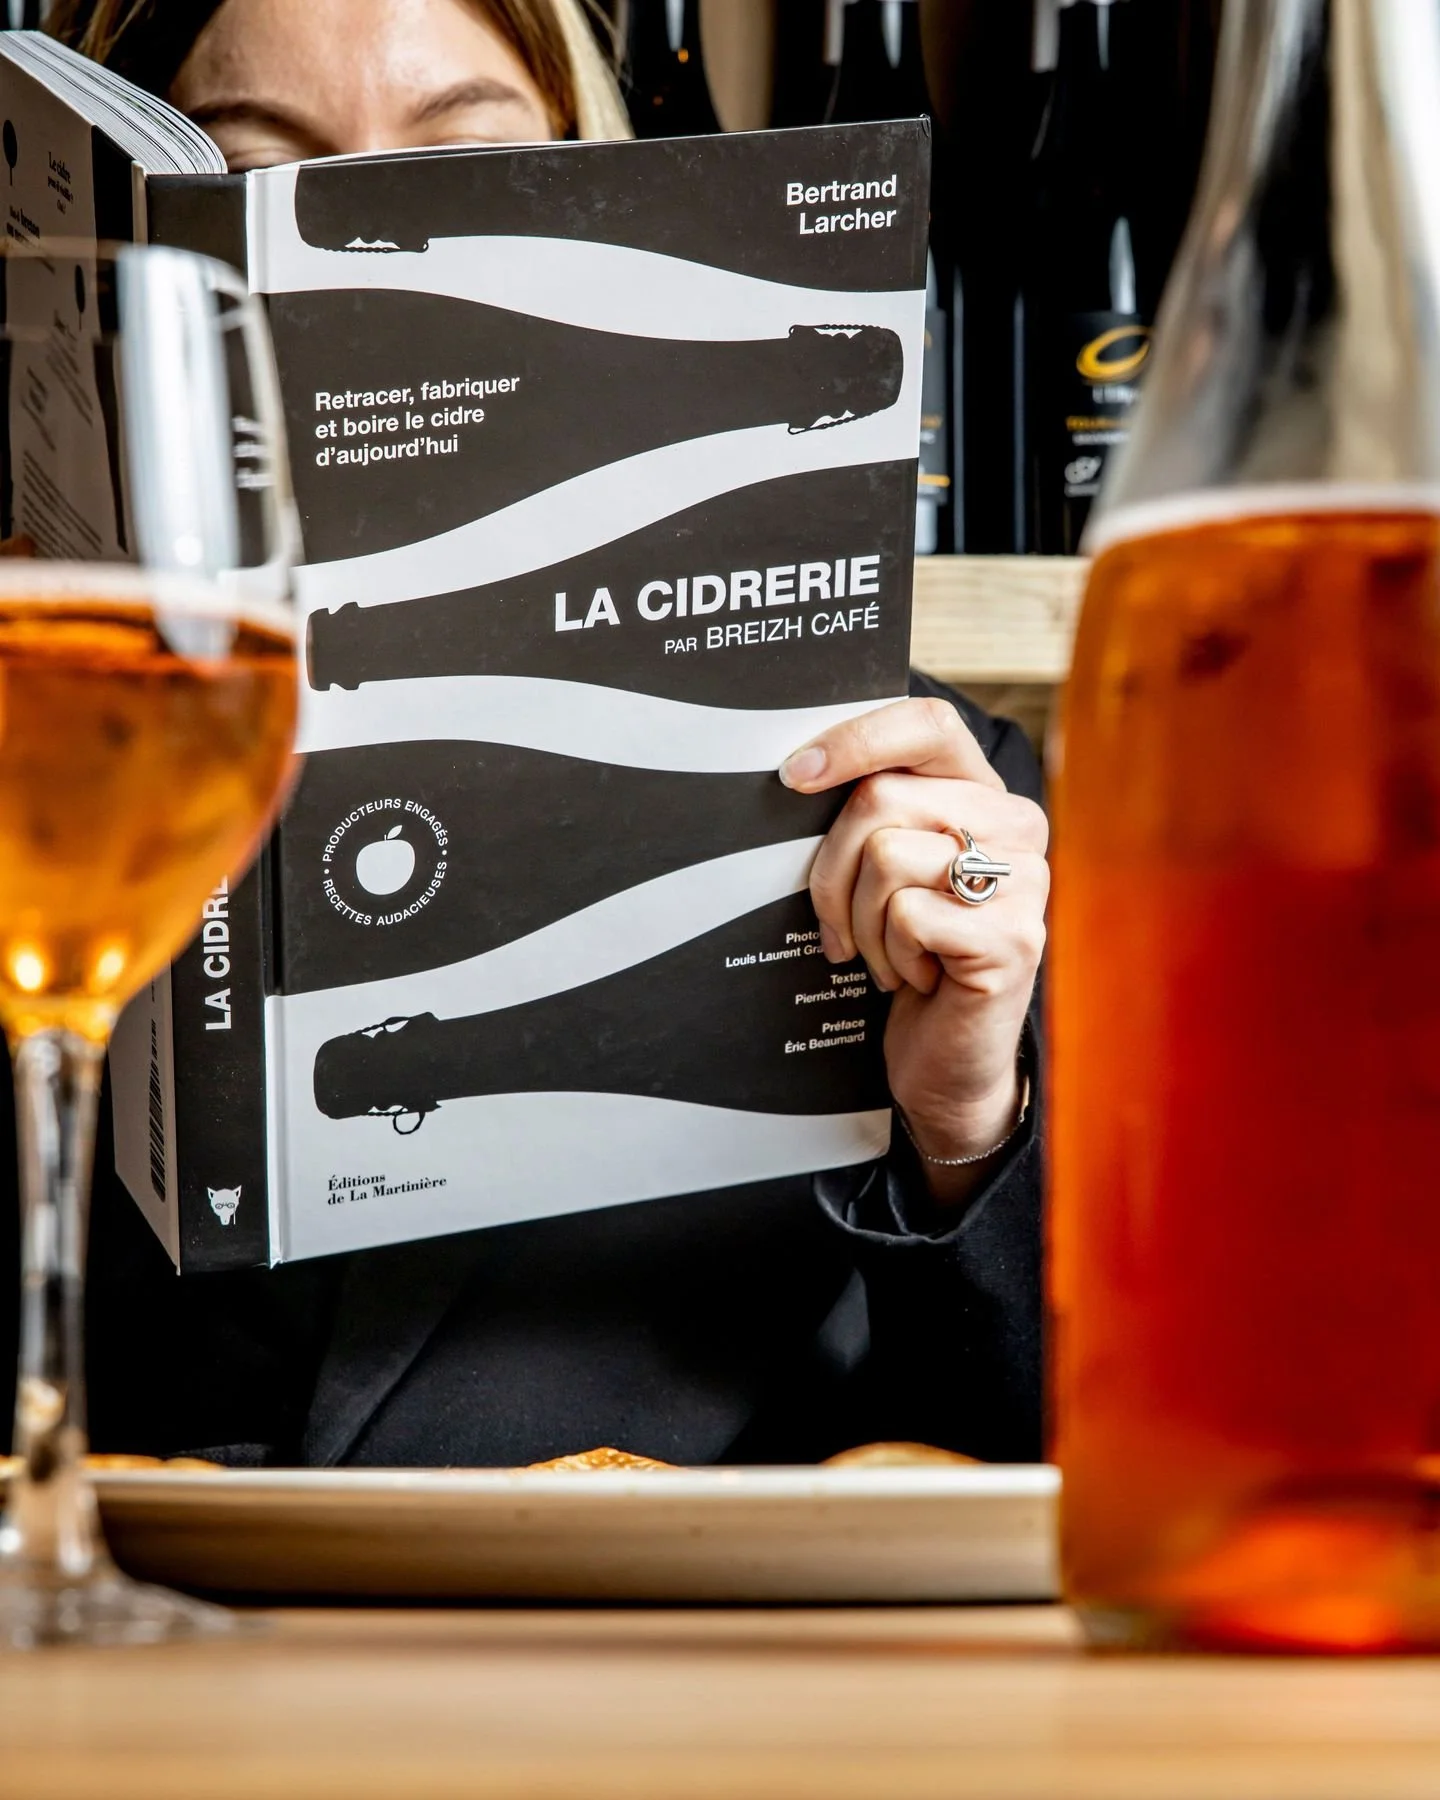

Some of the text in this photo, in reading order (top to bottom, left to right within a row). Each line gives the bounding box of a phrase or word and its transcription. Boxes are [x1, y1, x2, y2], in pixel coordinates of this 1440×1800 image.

[786, 174, 897, 205] Bertrand
[799, 207, 897, 234] Larcher
[315, 376, 520, 411] Retracer, fabriquer
[315, 406, 485, 439] et boire le cidre
[555, 554, 881, 632] LA CIDRERIE
[664, 602, 880, 654] PAR BREIZH CAFÉ
[322, 798, 448, 862] PRODUCTEURS ENGAGÉS
[322, 861, 447, 926] RECETTES AUDACIEUSES
[786, 931, 820, 944] Photo
[725, 944, 824, 968] Louis Laurent Gra
[830, 972, 867, 985] Textes
[205, 987, 232, 1031] LA
[795, 986, 867, 1005] Pierrick Jégu
[822, 1019, 866, 1034] Préface
[784, 1031, 865, 1054] Éric Beaumard
[327, 1177, 447, 1206] de La Martinière
[328, 1174, 386, 1191] Éditions
